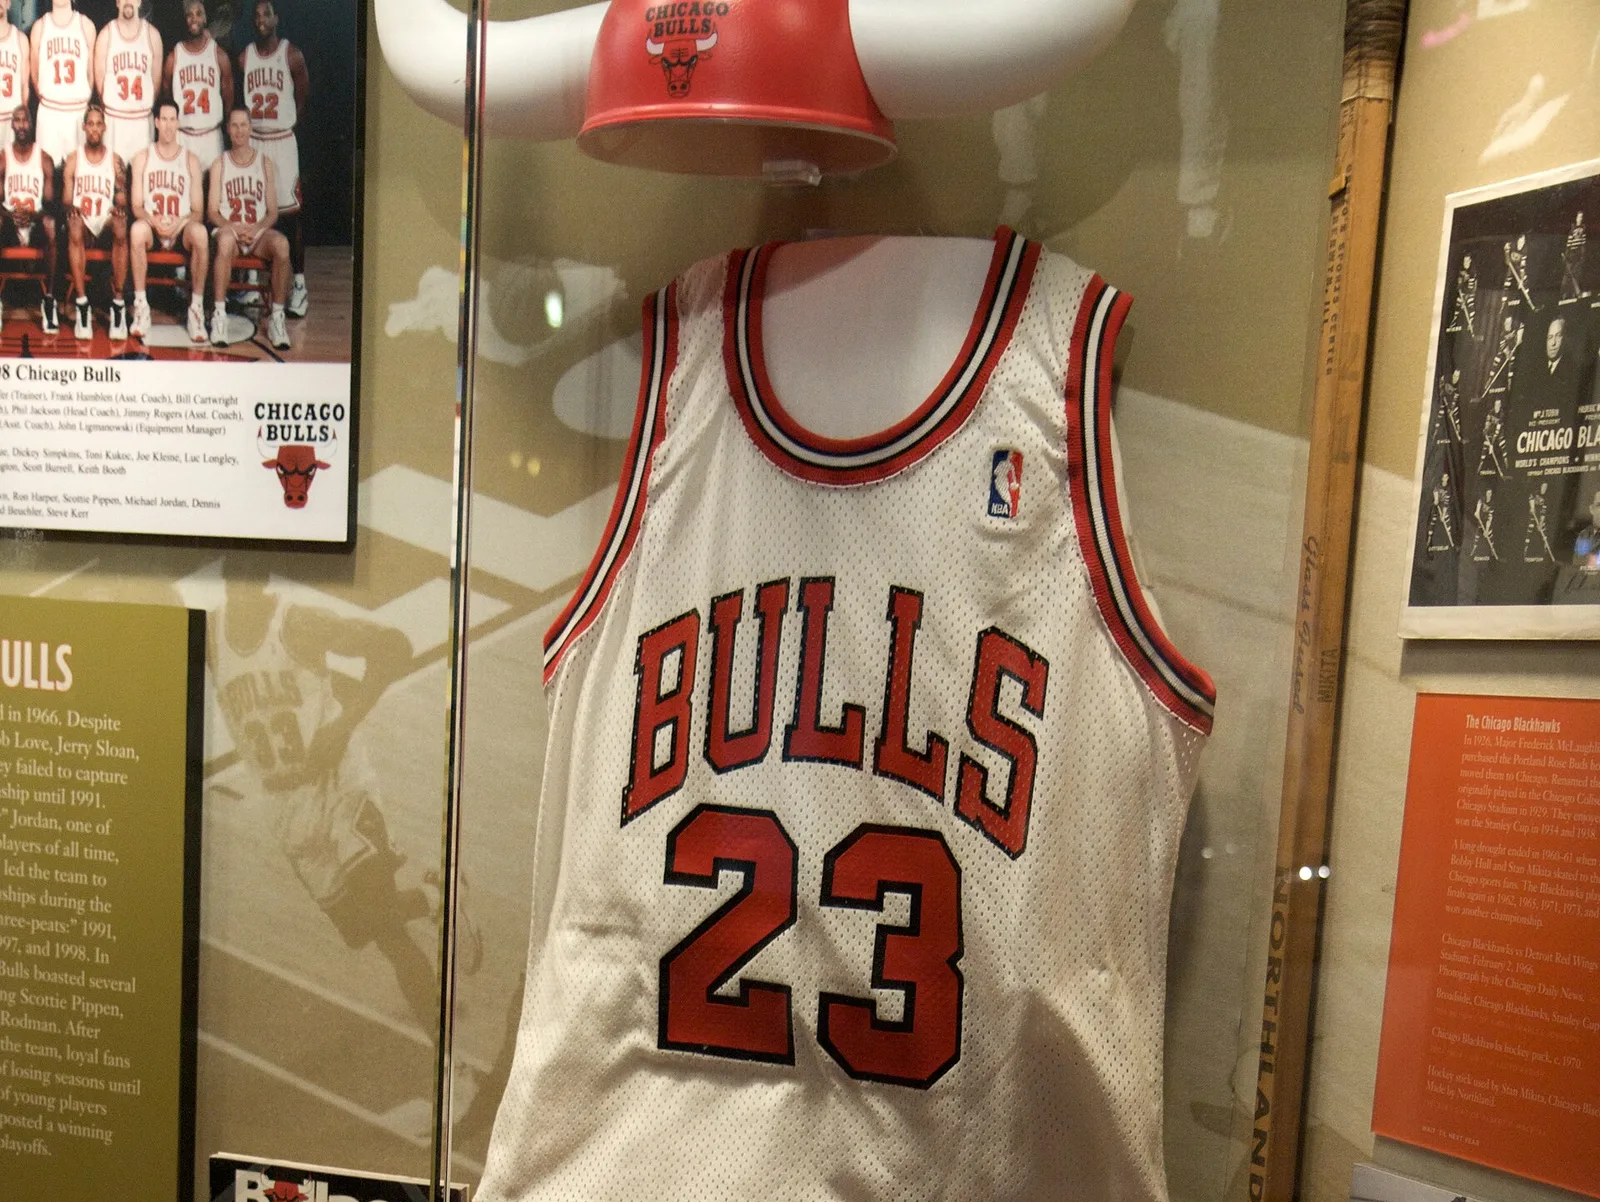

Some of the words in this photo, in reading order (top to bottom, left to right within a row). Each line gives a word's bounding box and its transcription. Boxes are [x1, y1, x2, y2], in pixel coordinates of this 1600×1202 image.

[645, 1, 729, 22] CHICAGO
[654, 18, 711, 38] BULLS
[47, 35, 81, 60] BULLS
[54, 60, 75, 84] 13
[113, 50, 148, 75] BULLS
[117, 75, 143, 101] 34
[179, 63, 215, 89] BULLS
[247, 67, 284, 93] BULLS
[183, 88, 210, 116] 24
[251, 93, 279, 120] 22
[7, 173, 39, 197] BULLS
[77, 175, 111, 201] BULLS
[148, 171, 185, 196] BULLS
[225, 176, 263, 201] BULLS
[229, 197, 257, 224] 25
[1326, 312, 1338, 375] CENTER
[0, 364, 10, 380] 8
[16, 364, 77, 386] Chicago
[84, 366, 121, 382] Bulls
[124, 408, 150, 419] Jimmy
[193, 394, 238, 407] Cartwright
[254, 402, 345, 421] CHICAGO
[186, 424, 226, 437] Manager)
[266, 424, 329, 442] BULLS
[1517, 427, 1573, 454] CHICAGO
[1577, 425, 1600, 448] BLA
[185, 452, 200, 463] Luc
[991, 503, 1009, 515] NBA
[8, 705, 21, 722] in
[67, 710, 121, 734] Despite
[620, 576, 1049, 860] BULLS
[1466, 714, 1480, 729] The
[1482, 715, 1512, 732] Chicago
[1513, 717, 1561, 733] Blackhawks
[15, 731, 53, 753] Love,
[55, 736, 92, 760] Jerry
[96, 740, 140, 761] Sloan,
[16, 757, 53, 777] failed
[57, 765, 72, 779] to
[75, 768, 128, 786] capture
[34, 788, 66, 804] until
[71, 790, 106, 808] 1991.
[10, 809, 62, 832] Jordan,
[66, 819, 93, 833] one
[96, 818, 113, 835] of
[45, 839, 61, 855] of
[63, 841, 79, 858] all
[84, 844, 119, 865] time,
[3, 859, 25, 877] led
[28, 862, 51, 880] the
[54, 869, 88, 885] team
[92, 874, 107, 887] to
[40, 889, 85, 915] during
[90, 896, 112, 913] the
[82, 922, 117, 942] 1991,
[25, 941, 50, 957] and
[95, 948, 110, 964] In
[656, 803, 964, 1090] 23
[34, 964, 85, 987] boasted
[89, 976, 136, 993] several
[20, 988, 67, 1010] Scottie
[71, 995, 124, 1019] Pippen,
[66, 1020, 101, 1039] After
[0, 1035, 22, 1053] the
[26, 1042, 62, 1062] team,
[66, 1044, 99, 1067] loyal
[103, 1049, 131, 1069] fans
[12, 1060, 51, 1086] losing
[54, 1073, 105, 1091] seasons
[109, 1079, 141, 1096] until
[13, 1090, 55, 1111] young
[59, 1094, 108, 1117] players
[0, 1113, 43, 1131] posted
[57, 1120, 114, 1146] winning
